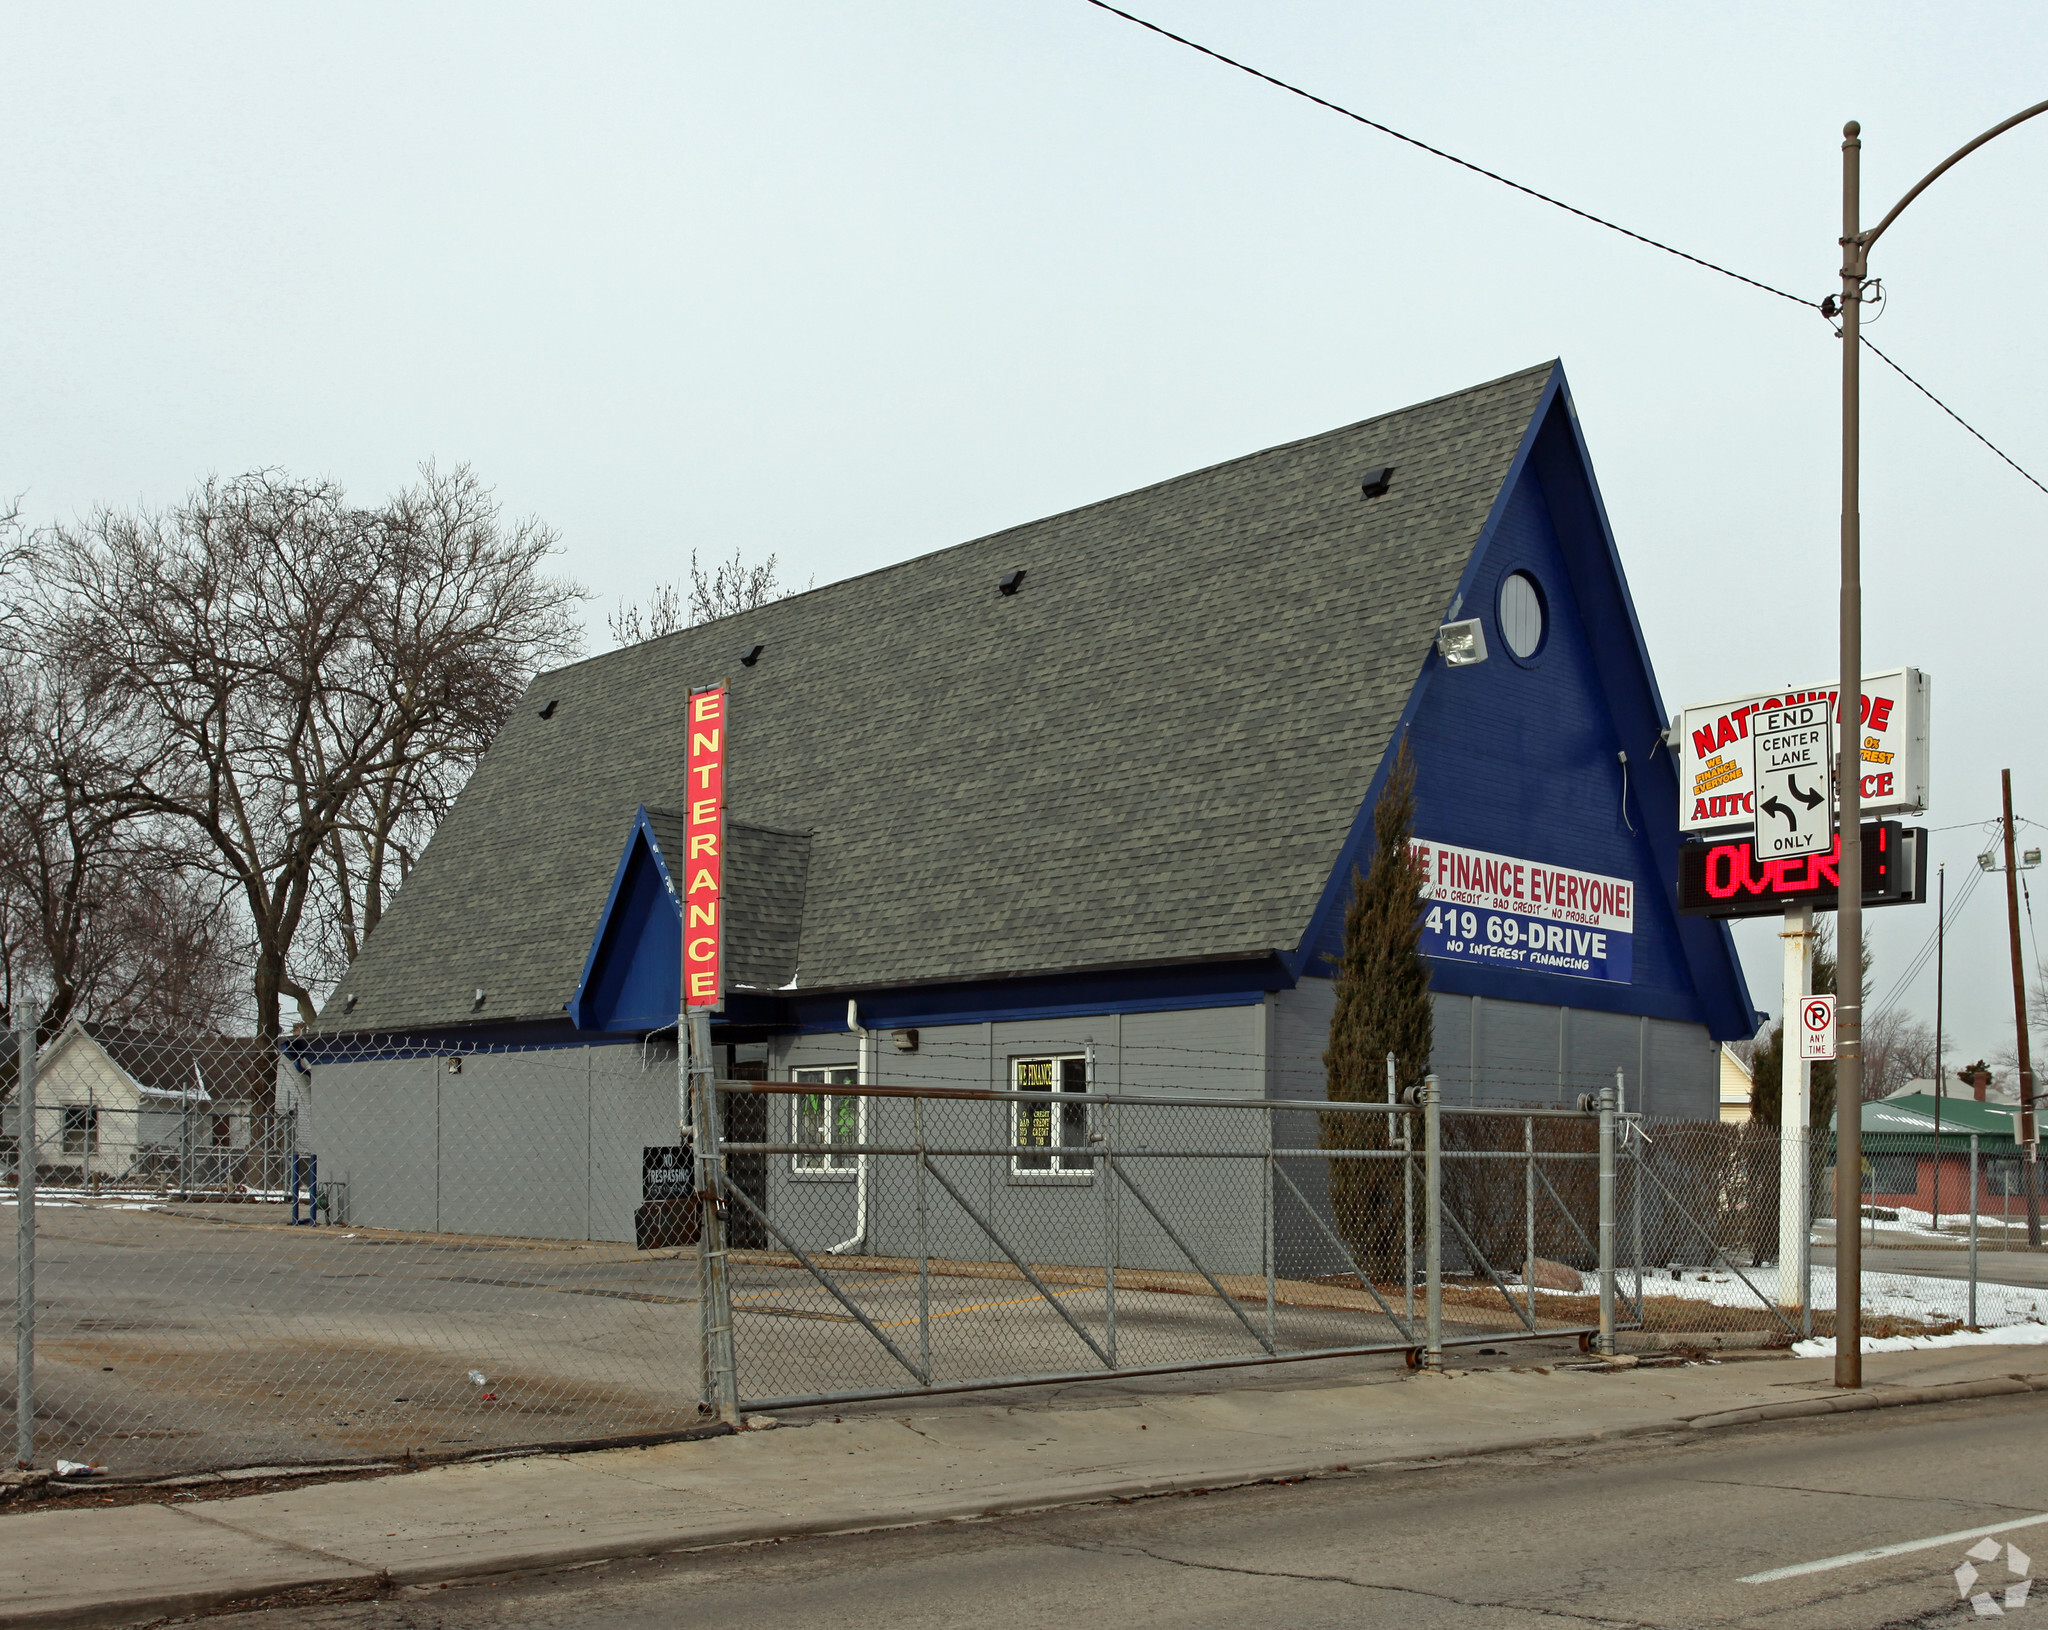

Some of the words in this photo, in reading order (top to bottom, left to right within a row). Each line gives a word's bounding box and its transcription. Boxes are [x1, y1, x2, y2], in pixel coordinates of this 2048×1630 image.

[1692, 692, 1894, 760] NATDE
[1768, 708, 1814, 730] END
[1763, 731, 1819, 751] CENTER
[1705, 755, 1723, 769] WE
[1772, 749, 1811, 766] LANE
[1693, 767, 1743, 796] EVERYONE
[1695, 760, 1737, 784] FINANCE
[688, 694, 720, 997] ENTERANCE
[1773, 834, 1813, 850] ONLY
[1438, 850, 1524, 899] FINANCE
[1531, 868, 1630, 918] EVERYONE!
[1435, 888, 1447, 899] NO
[1450, 890, 1482, 905] CREDIT
[1493, 898, 1509, 910] BAD
[1513, 901, 1542, 915] CREDIT
[1552, 908, 1562, 919] NO
[1566, 911, 1600, 925] PROBLEM
[1425, 906, 1477, 939] 419
[1487, 916, 1607, 960] 69-DRIVE
[1447, 940, 1464, 952] NO
[1469, 943, 1526, 961] INTEREST
[1530, 952, 1589, 970] FINANCING
[1809, 1034, 1825, 1043] ANY
[1809, 1045, 1826, 1054] TIME
[1028, 1064, 1052, 1086] FINANCE
[663, 1154, 672, 1168] NO
[648, 1169, 689, 1183] TRESPASSING
